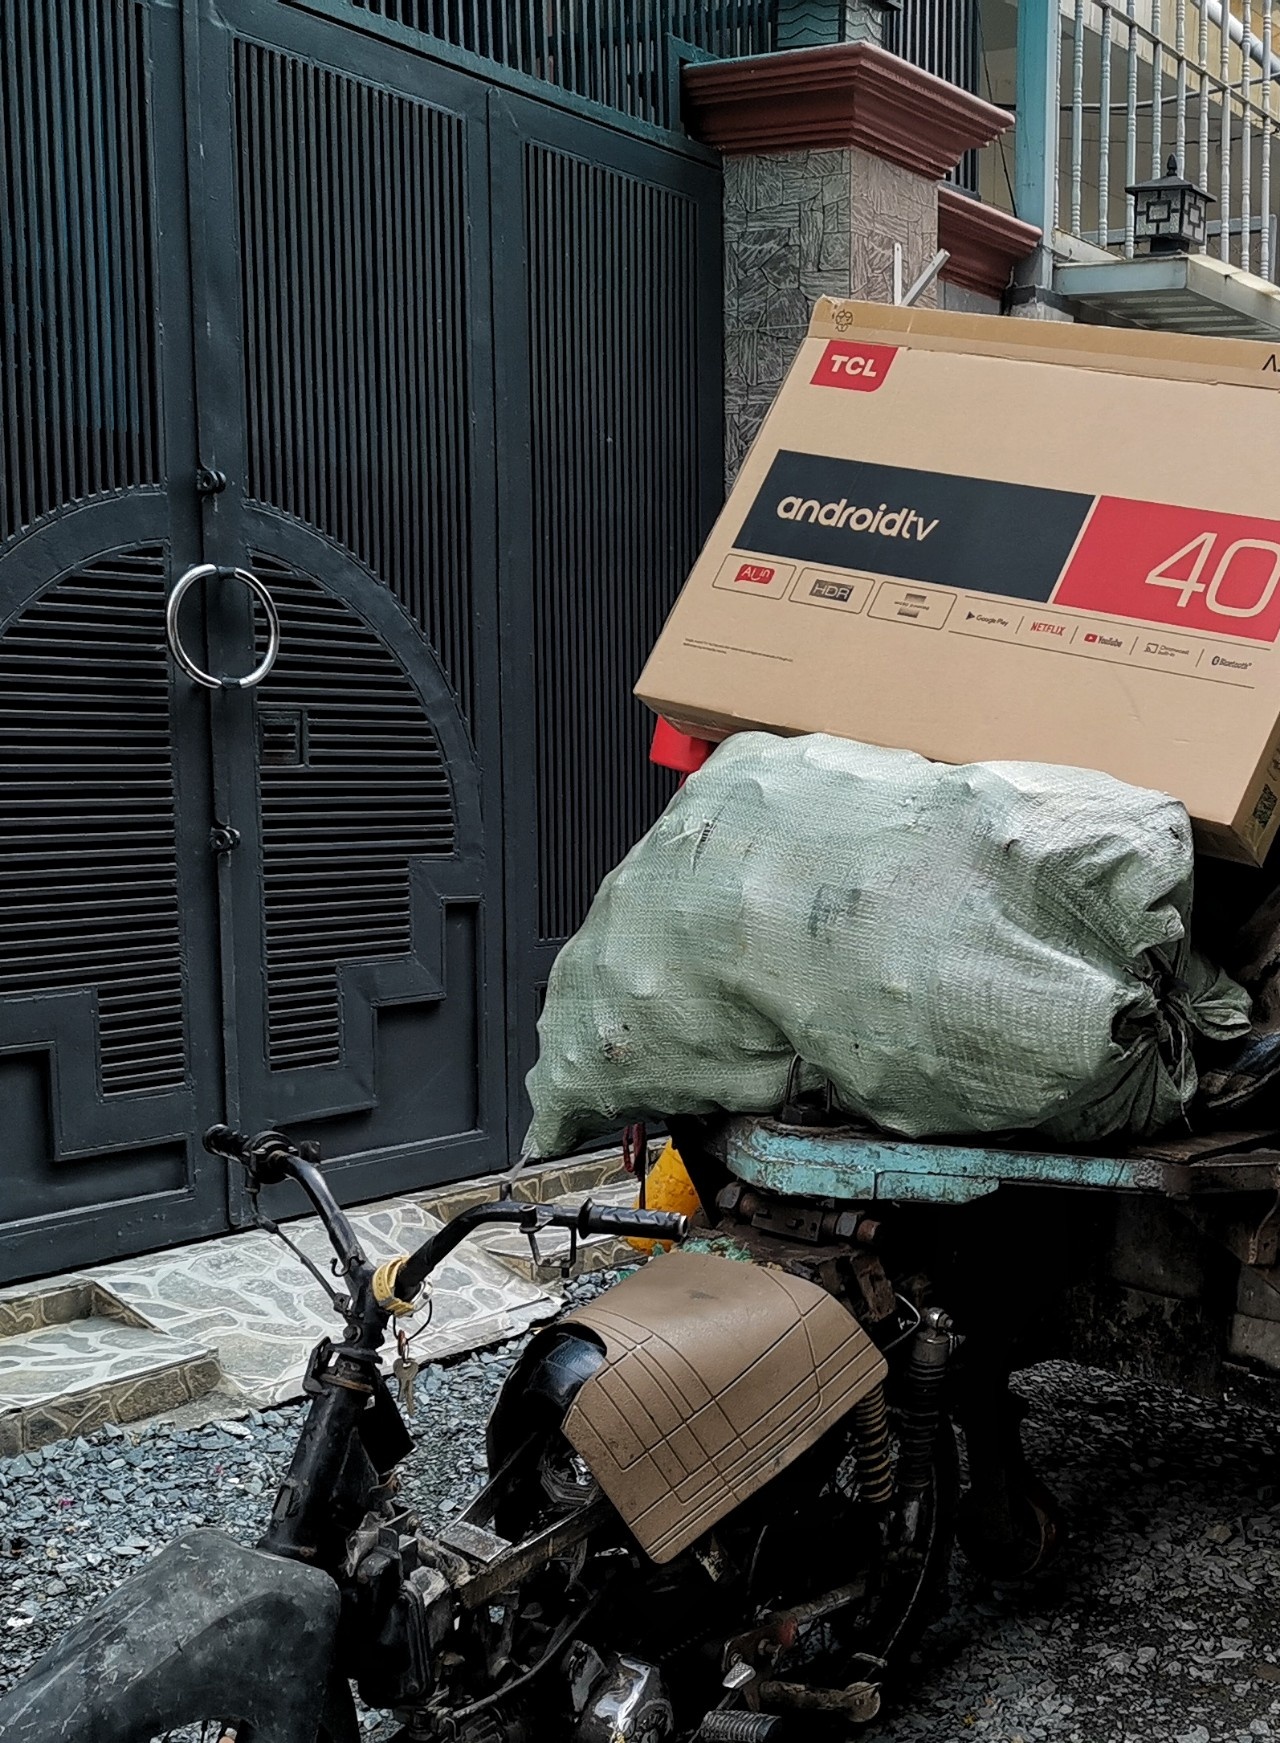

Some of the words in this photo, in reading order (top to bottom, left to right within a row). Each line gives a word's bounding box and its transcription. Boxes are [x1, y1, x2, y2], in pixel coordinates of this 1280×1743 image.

[830, 354, 877, 378] TCL
[776, 495, 940, 542] androidtv
[812, 582, 851, 600] HDR
[975, 614, 997, 625] Google
[1029, 621, 1067, 637] NETFLIX
[1097, 635, 1123, 648] YouTube
